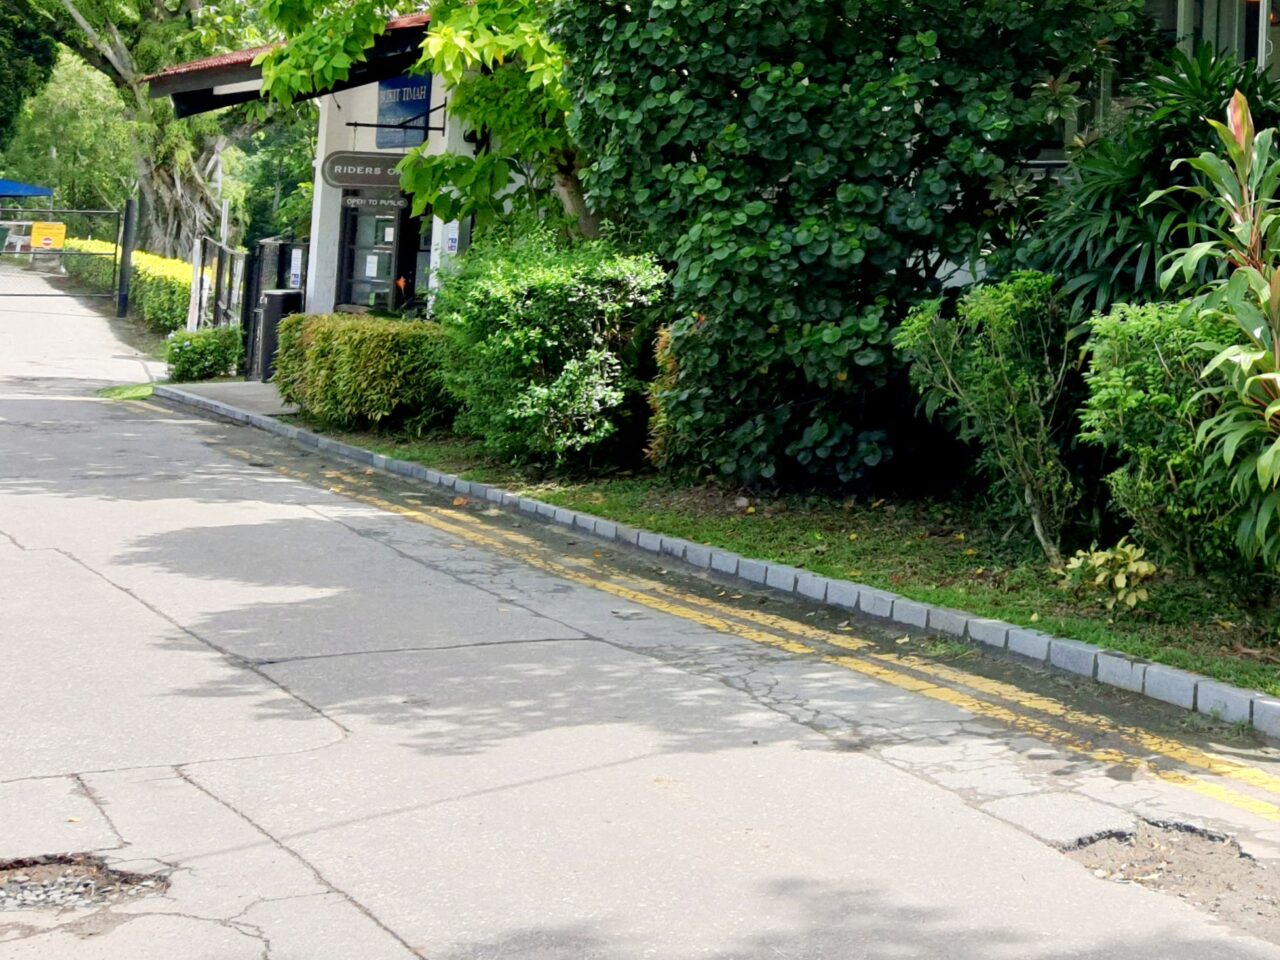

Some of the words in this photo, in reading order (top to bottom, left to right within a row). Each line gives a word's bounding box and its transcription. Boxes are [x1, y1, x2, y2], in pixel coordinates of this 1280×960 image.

[402, 86, 427, 101] TIMAH
[334, 165, 381, 175] RIDERS
[346, 198, 366, 206] OPEN
